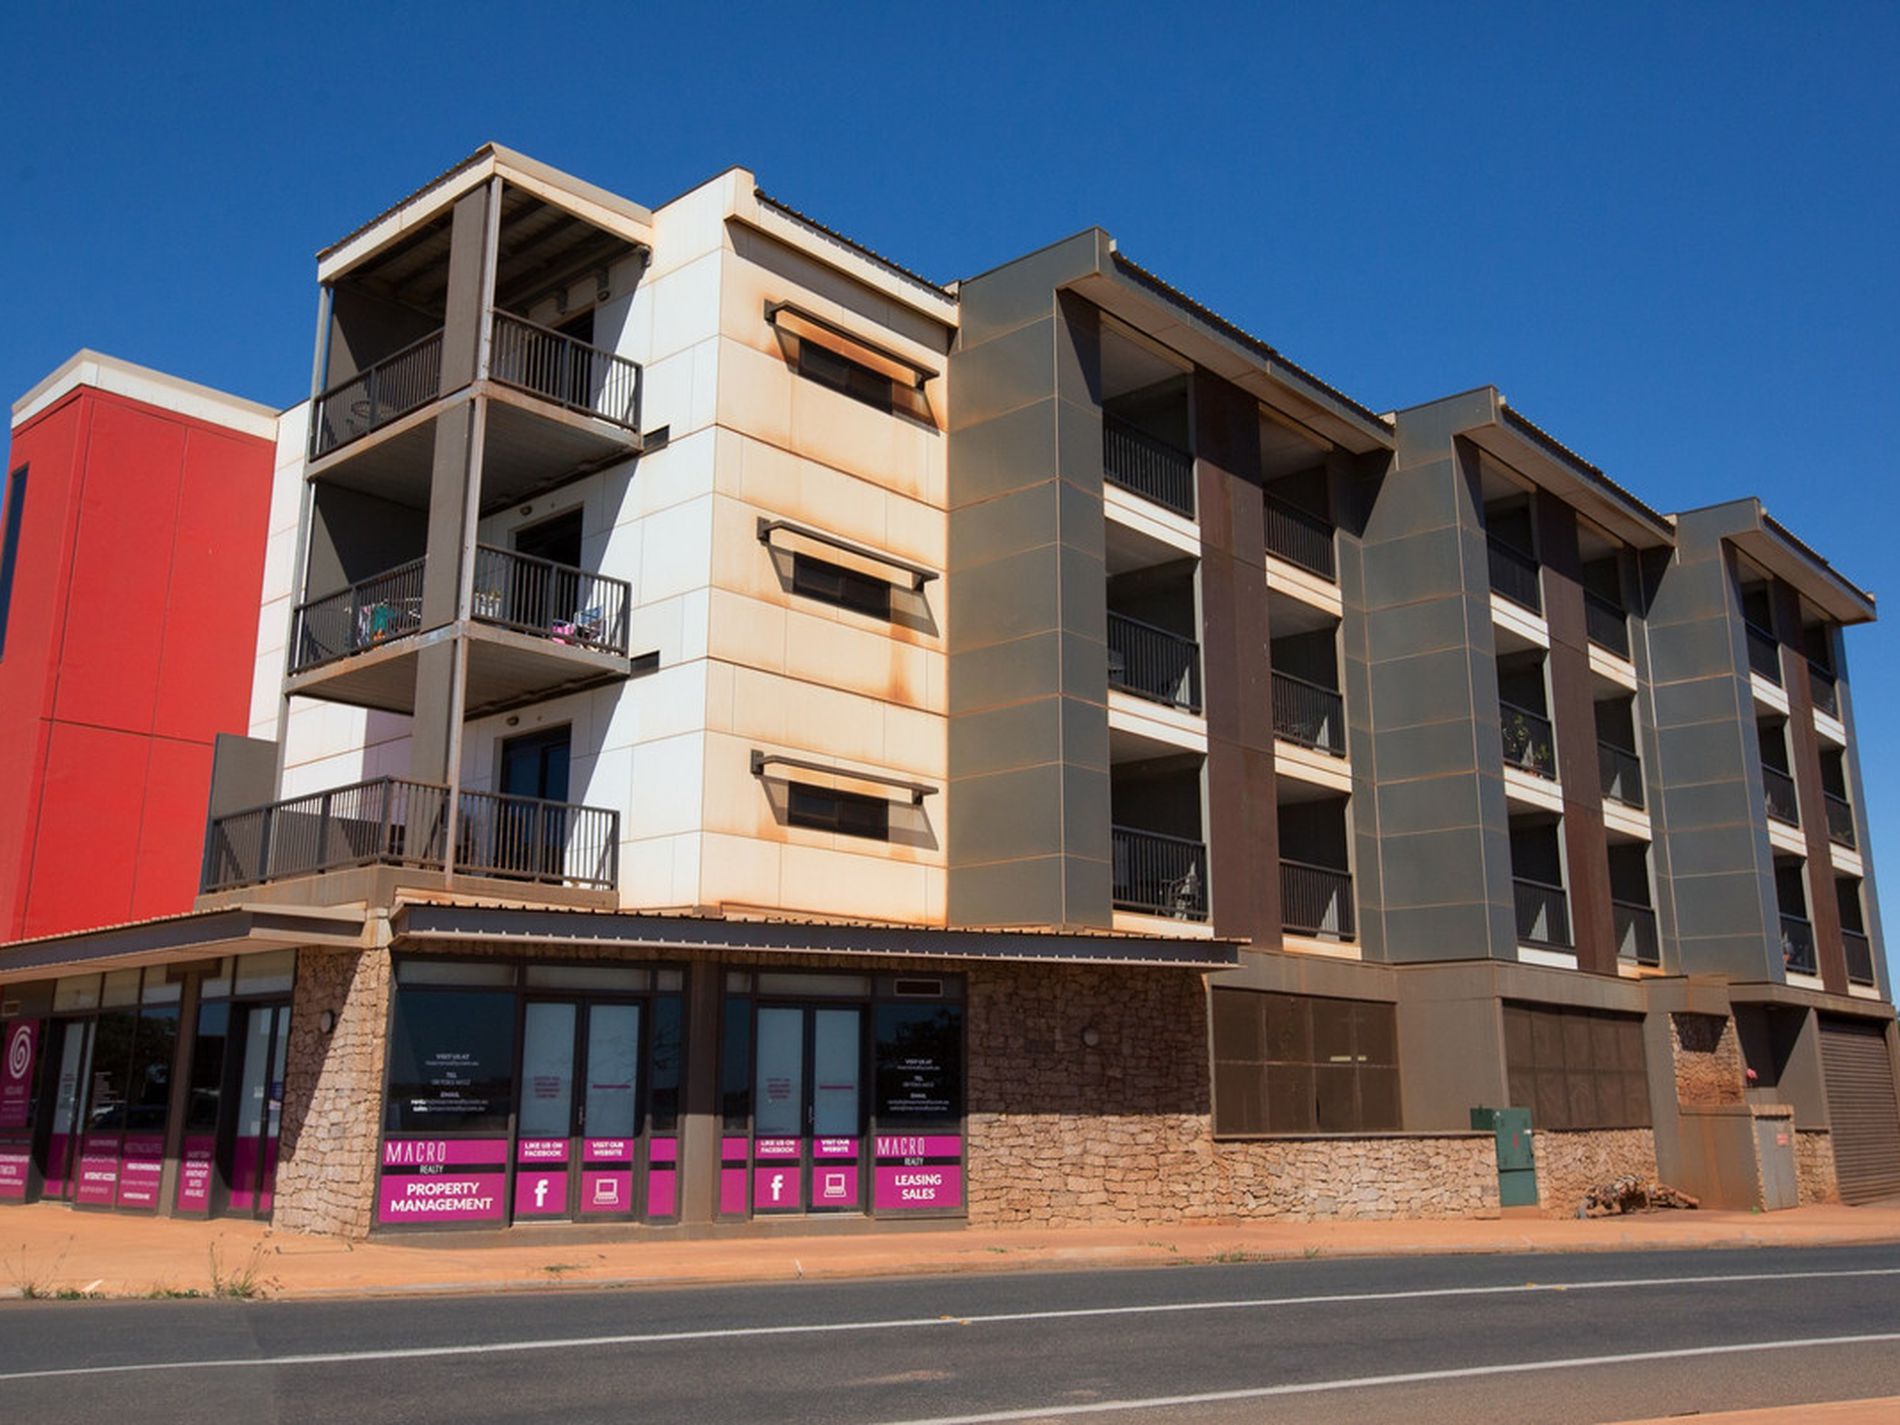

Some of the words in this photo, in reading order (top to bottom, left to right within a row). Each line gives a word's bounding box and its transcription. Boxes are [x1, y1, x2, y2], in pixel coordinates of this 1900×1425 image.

[592, 1141, 608, 1149] VISIT
[609, 1141, 624, 1149] OUR
[760, 1146, 795, 1154] FACEBOOK
[876, 1137, 925, 1156] MACRO
[385, 1141, 447, 1163] MACRO
[904, 1157, 925, 1166] REALTY
[419, 1165, 445, 1175] REALTY
[894, 1173, 942, 1187] LEASING
[406, 1182, 480, 1196] PROPERTY
[901, 1188, 936, 1200] SALES
[390, 1197, 494, 1212] MANAGEMENT
